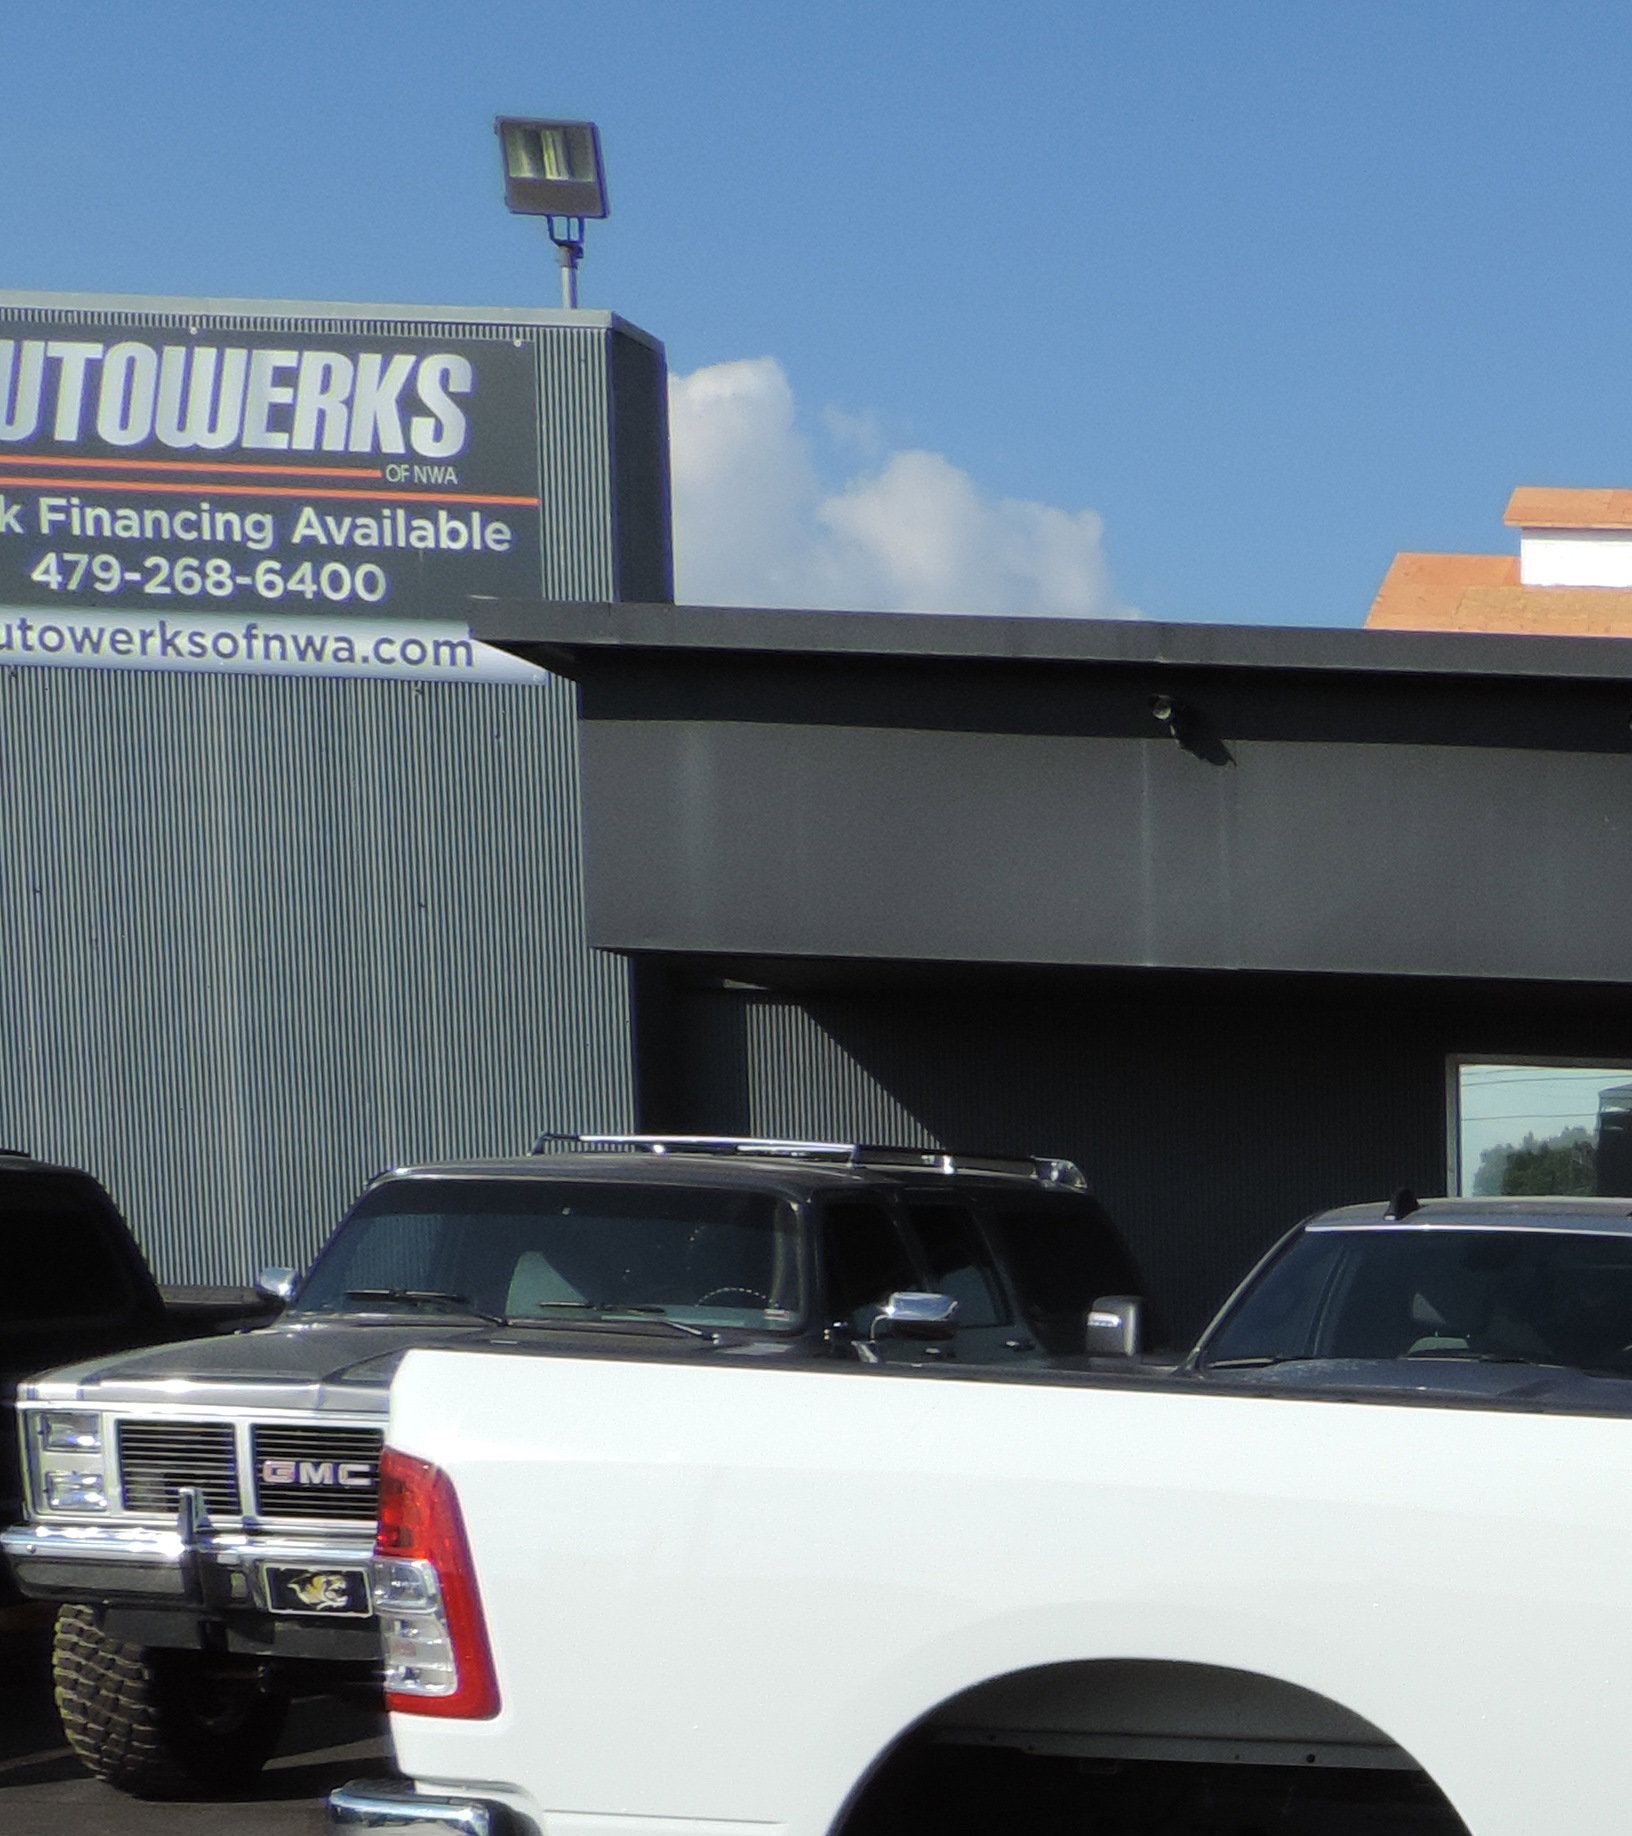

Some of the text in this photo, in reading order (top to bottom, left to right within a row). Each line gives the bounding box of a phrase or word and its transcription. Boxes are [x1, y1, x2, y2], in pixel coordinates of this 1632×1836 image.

[0, 339, 472, 458] UTOWERKS
[386, 464, 458, 485] OF NWA
[38, 497, 274, 550] Financing
[291, 506, 513, 551] Available
[30, 552, 388, 602] 479-268-6400
[262, 1460, 372, 1486] GMC
